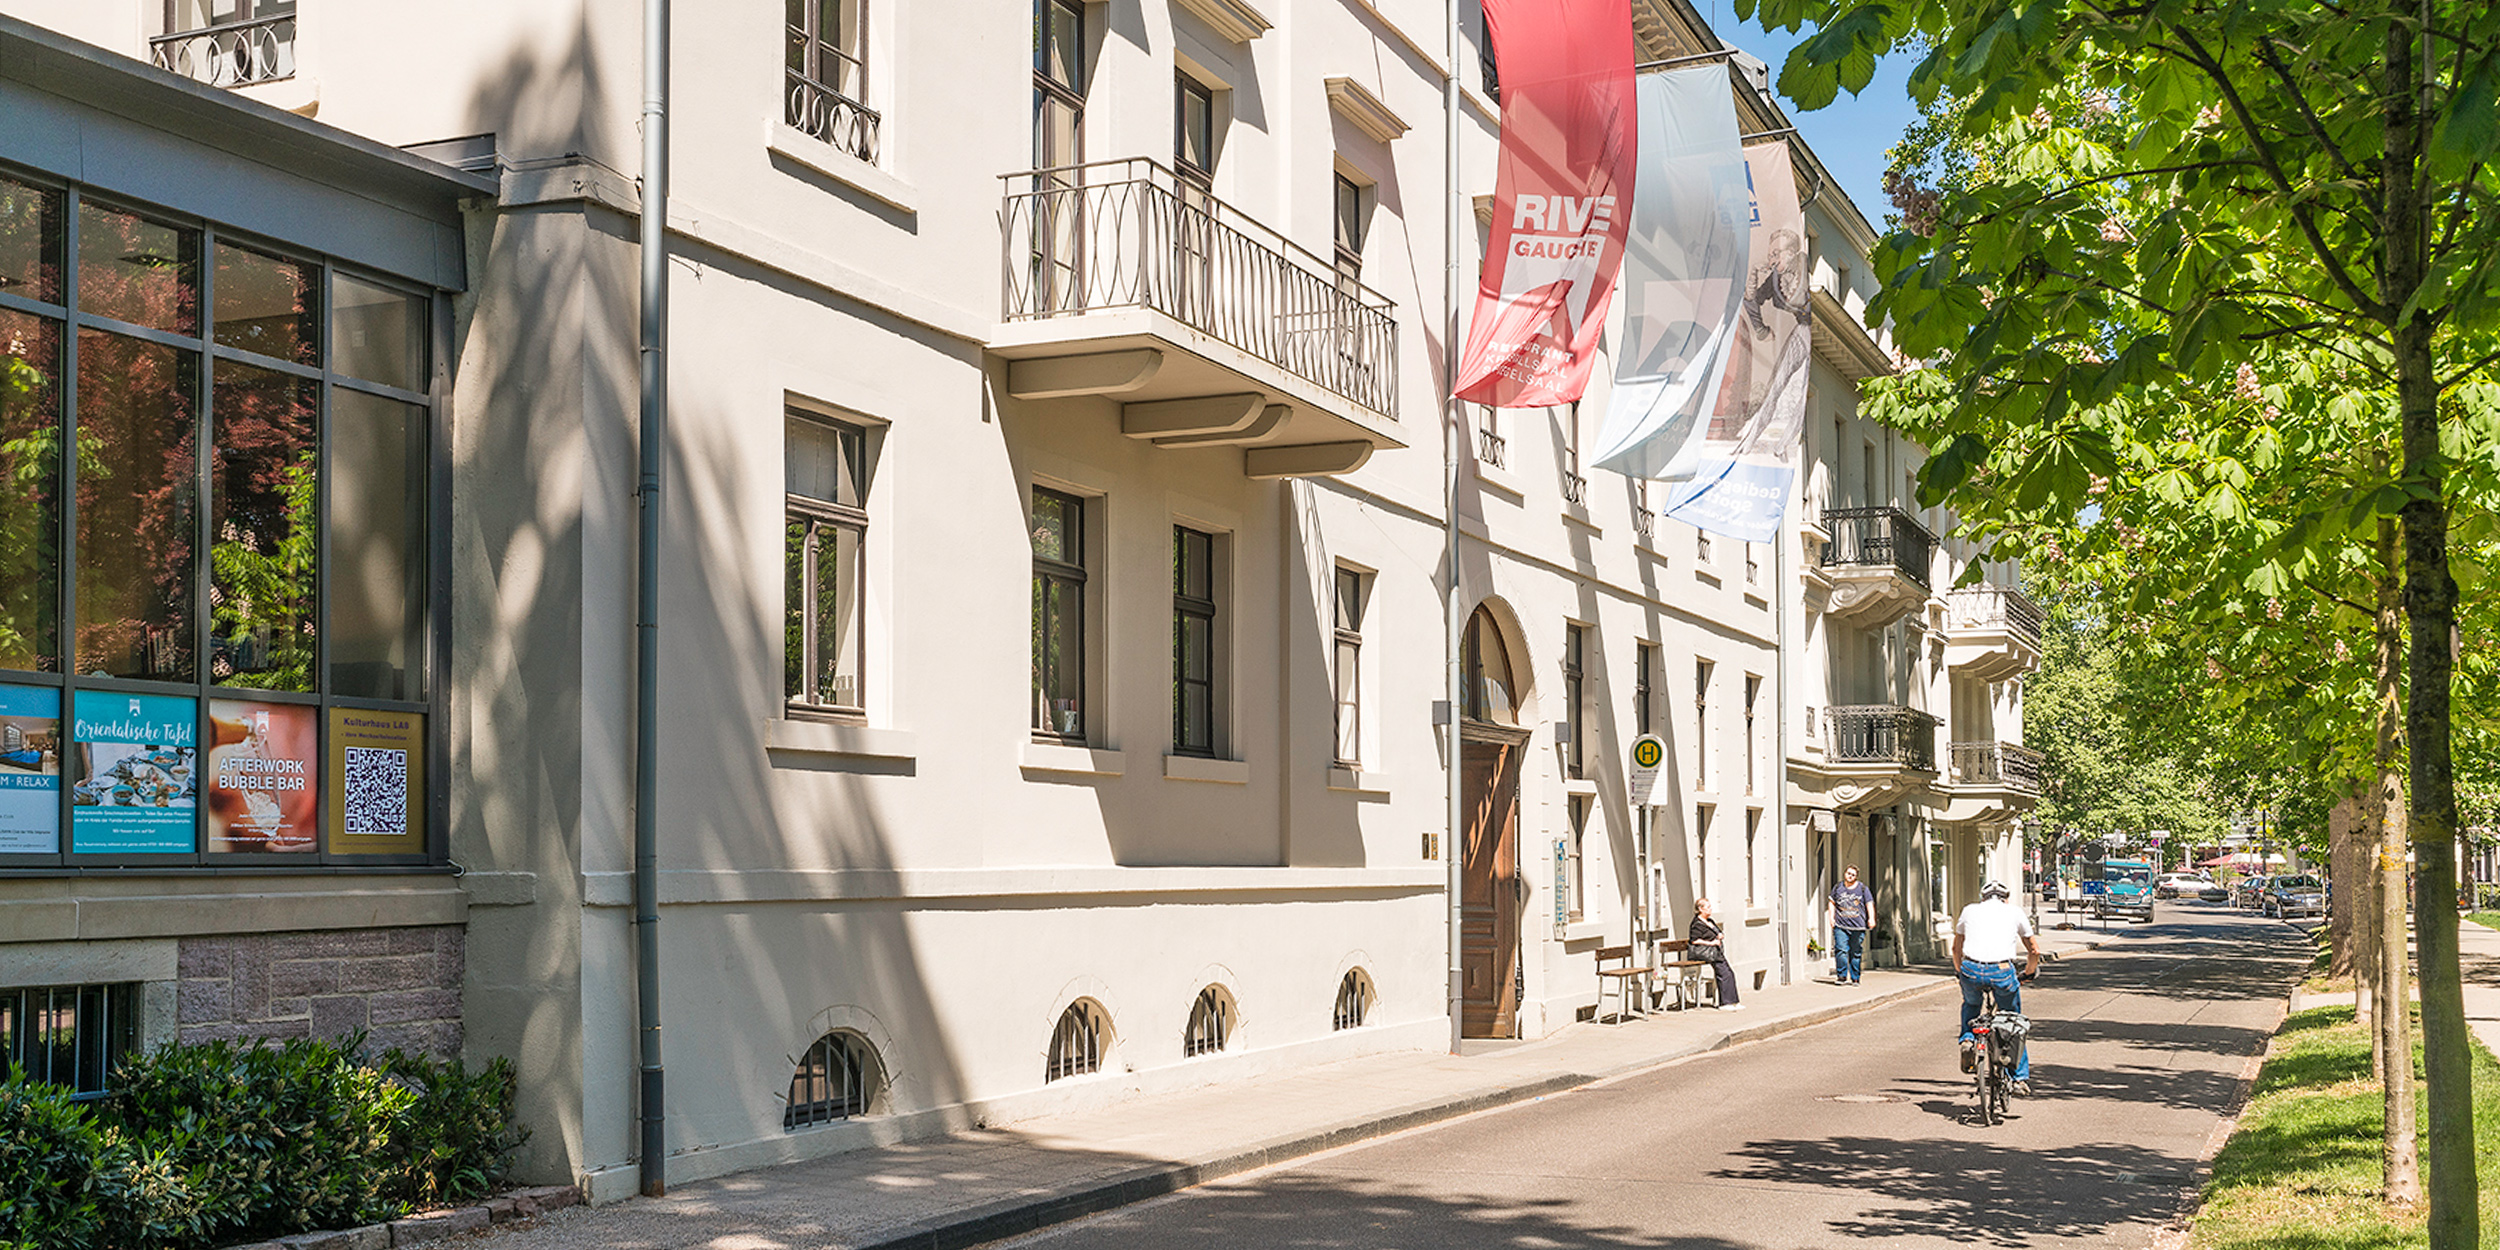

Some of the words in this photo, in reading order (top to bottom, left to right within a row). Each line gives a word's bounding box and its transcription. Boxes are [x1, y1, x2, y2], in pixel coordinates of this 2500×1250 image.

[1512, 193, 1617, 233] RIVE
[75, 718, 161, 742] Orientalische
[163, 722, 192, 745] Tafel
[343, 717, 390, 729] Kulturhaus
[219, 757, 305, 774] AFTERWORK
[16, 776, 50, 788] RELAX
[218, 774, 274, 790] BUBBLE
[277, 776, 306, 791] BAR
